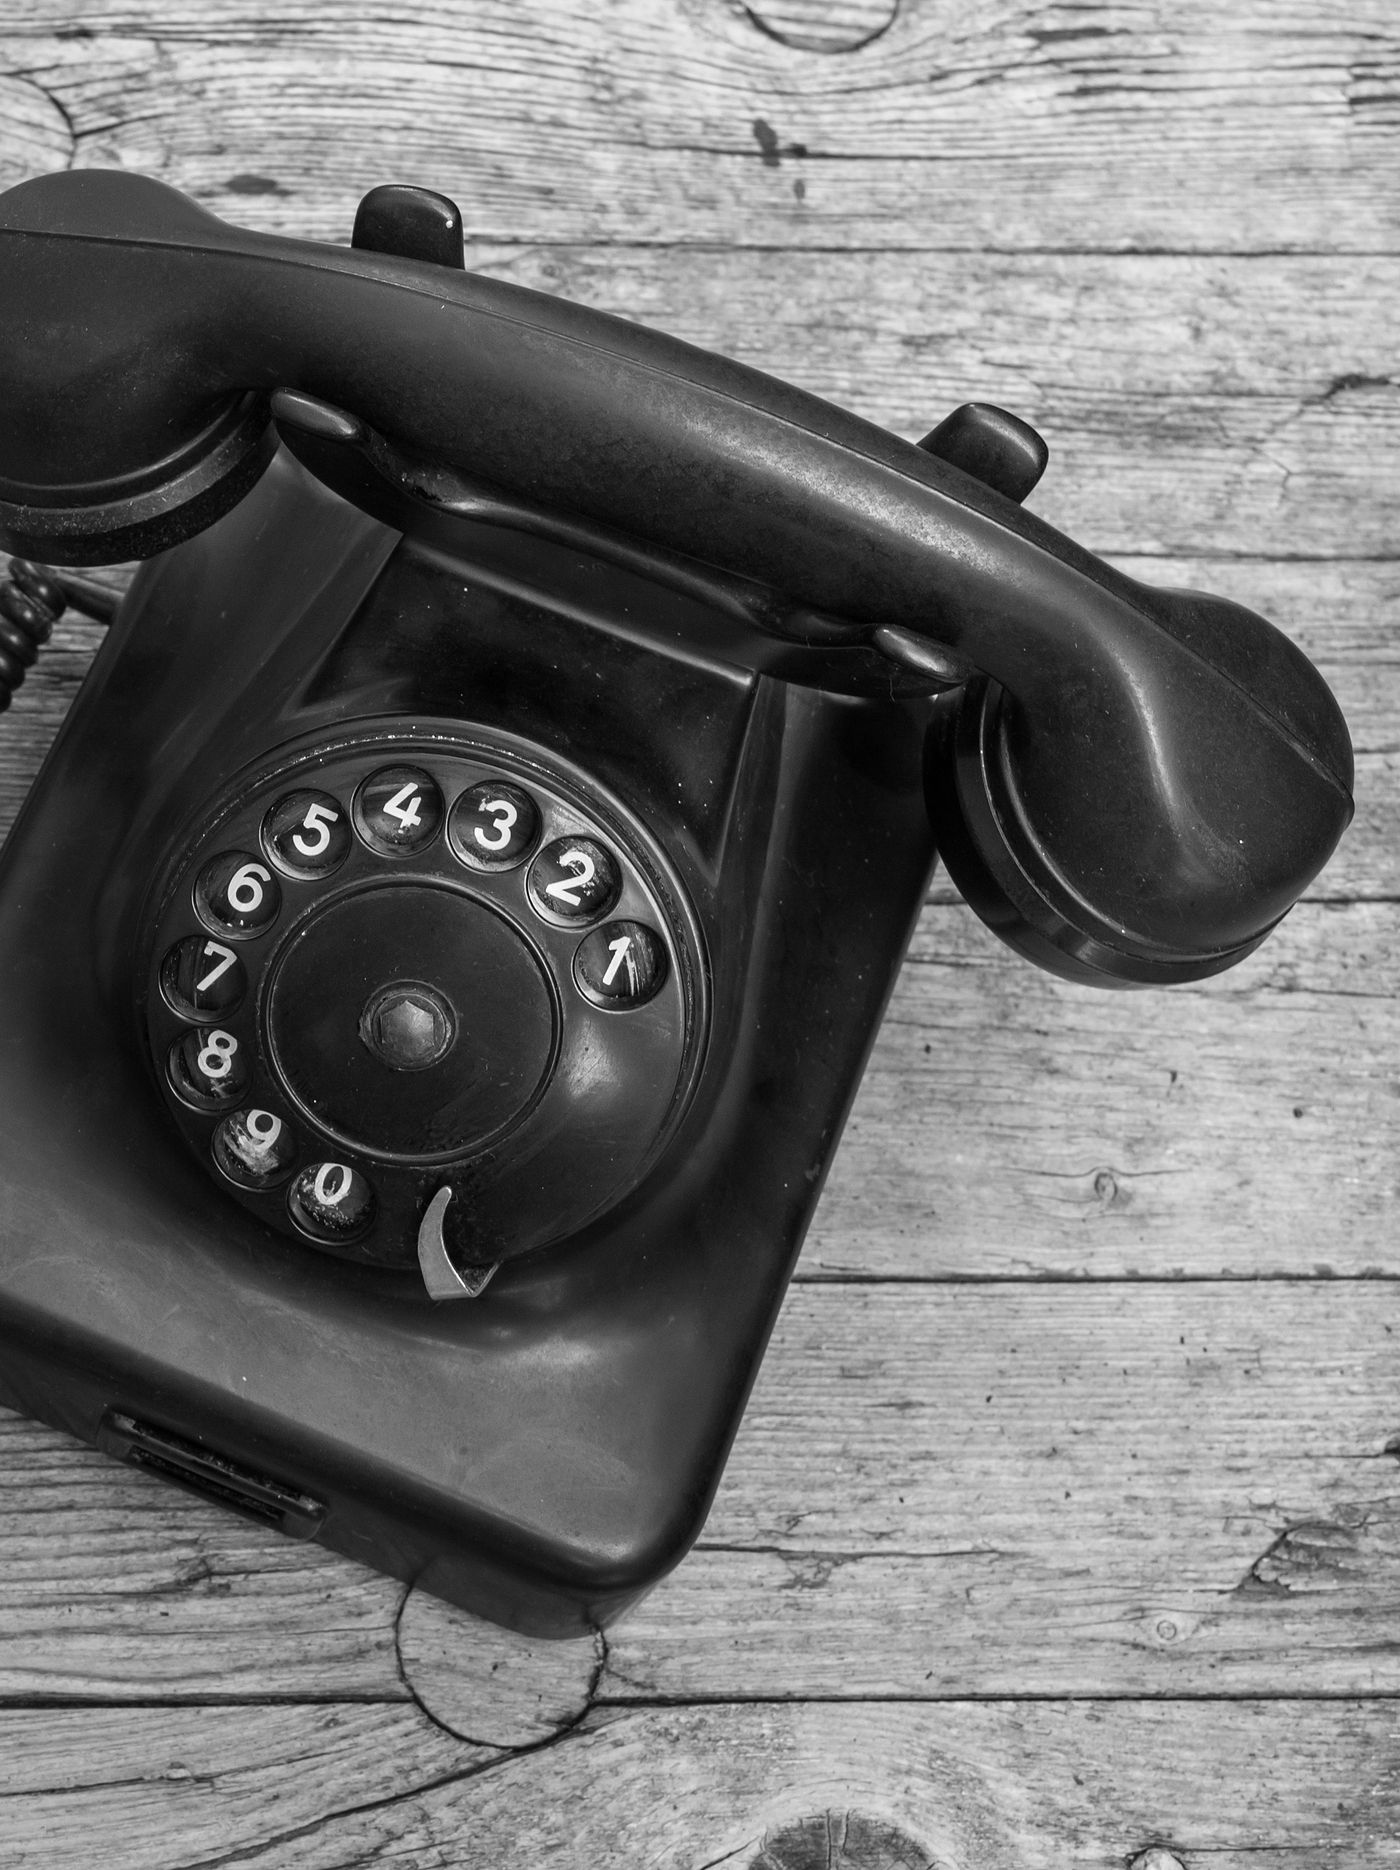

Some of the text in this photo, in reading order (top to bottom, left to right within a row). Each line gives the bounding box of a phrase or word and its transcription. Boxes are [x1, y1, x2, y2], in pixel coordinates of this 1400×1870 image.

[292, 803, 338, 857] 5
[382, 782, 422, 829] 4
[473, 799, 518, 851] 3
[227, 863, 271, 913] 6
[545, 851, 595, 906] 2
[196, 941, 237, 991] 7
[602, 935, 631, 986] 1
[197, 1030, 238, 1078] 8
[246, 1109, 282, 1156] 9
[313, 1163, 353, 1206] 0
